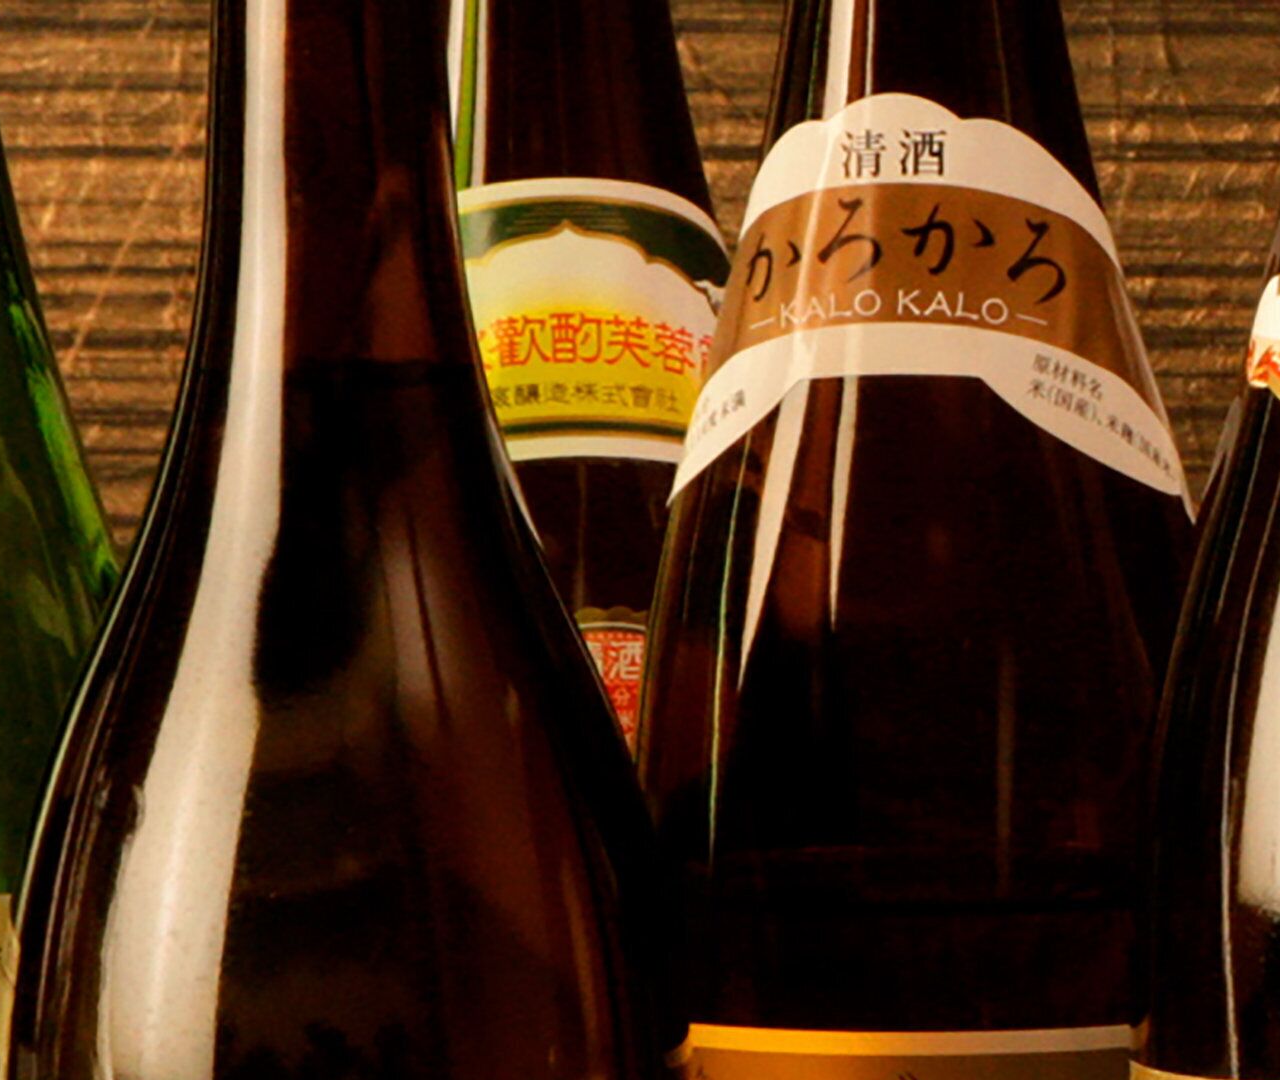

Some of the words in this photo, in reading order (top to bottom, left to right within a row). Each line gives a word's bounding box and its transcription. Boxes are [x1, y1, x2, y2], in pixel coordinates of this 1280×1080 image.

[840, 129, 948, 178] 清酒
[745, 198, 1067, 305] かろかろ
[780, 288, 882, 326] KALO
[896, 288, 1009, 326] KALO
